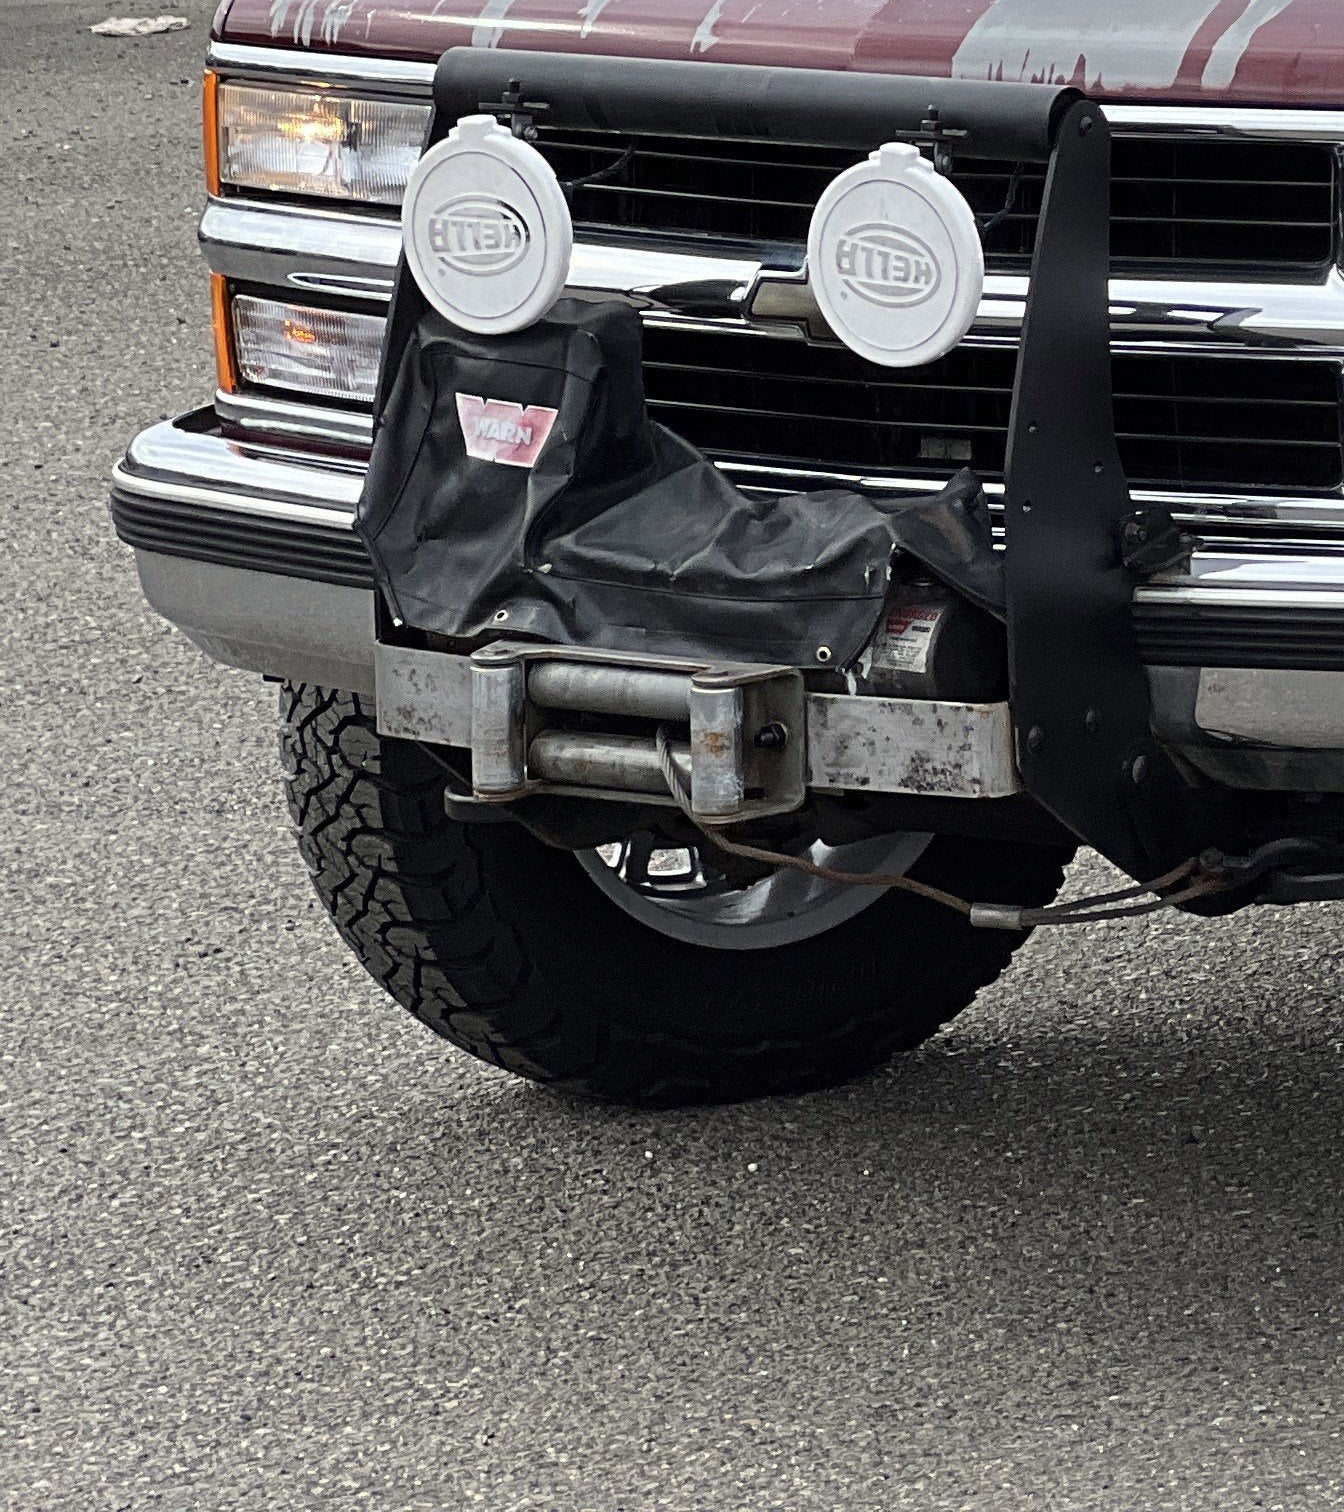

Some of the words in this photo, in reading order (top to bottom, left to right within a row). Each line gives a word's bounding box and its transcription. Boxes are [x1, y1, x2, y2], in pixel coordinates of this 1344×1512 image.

[428, 217, 522, 253] HELLA
[836, 238, 935, 285] HELLA
[475, 416, 533, 445] WARN
